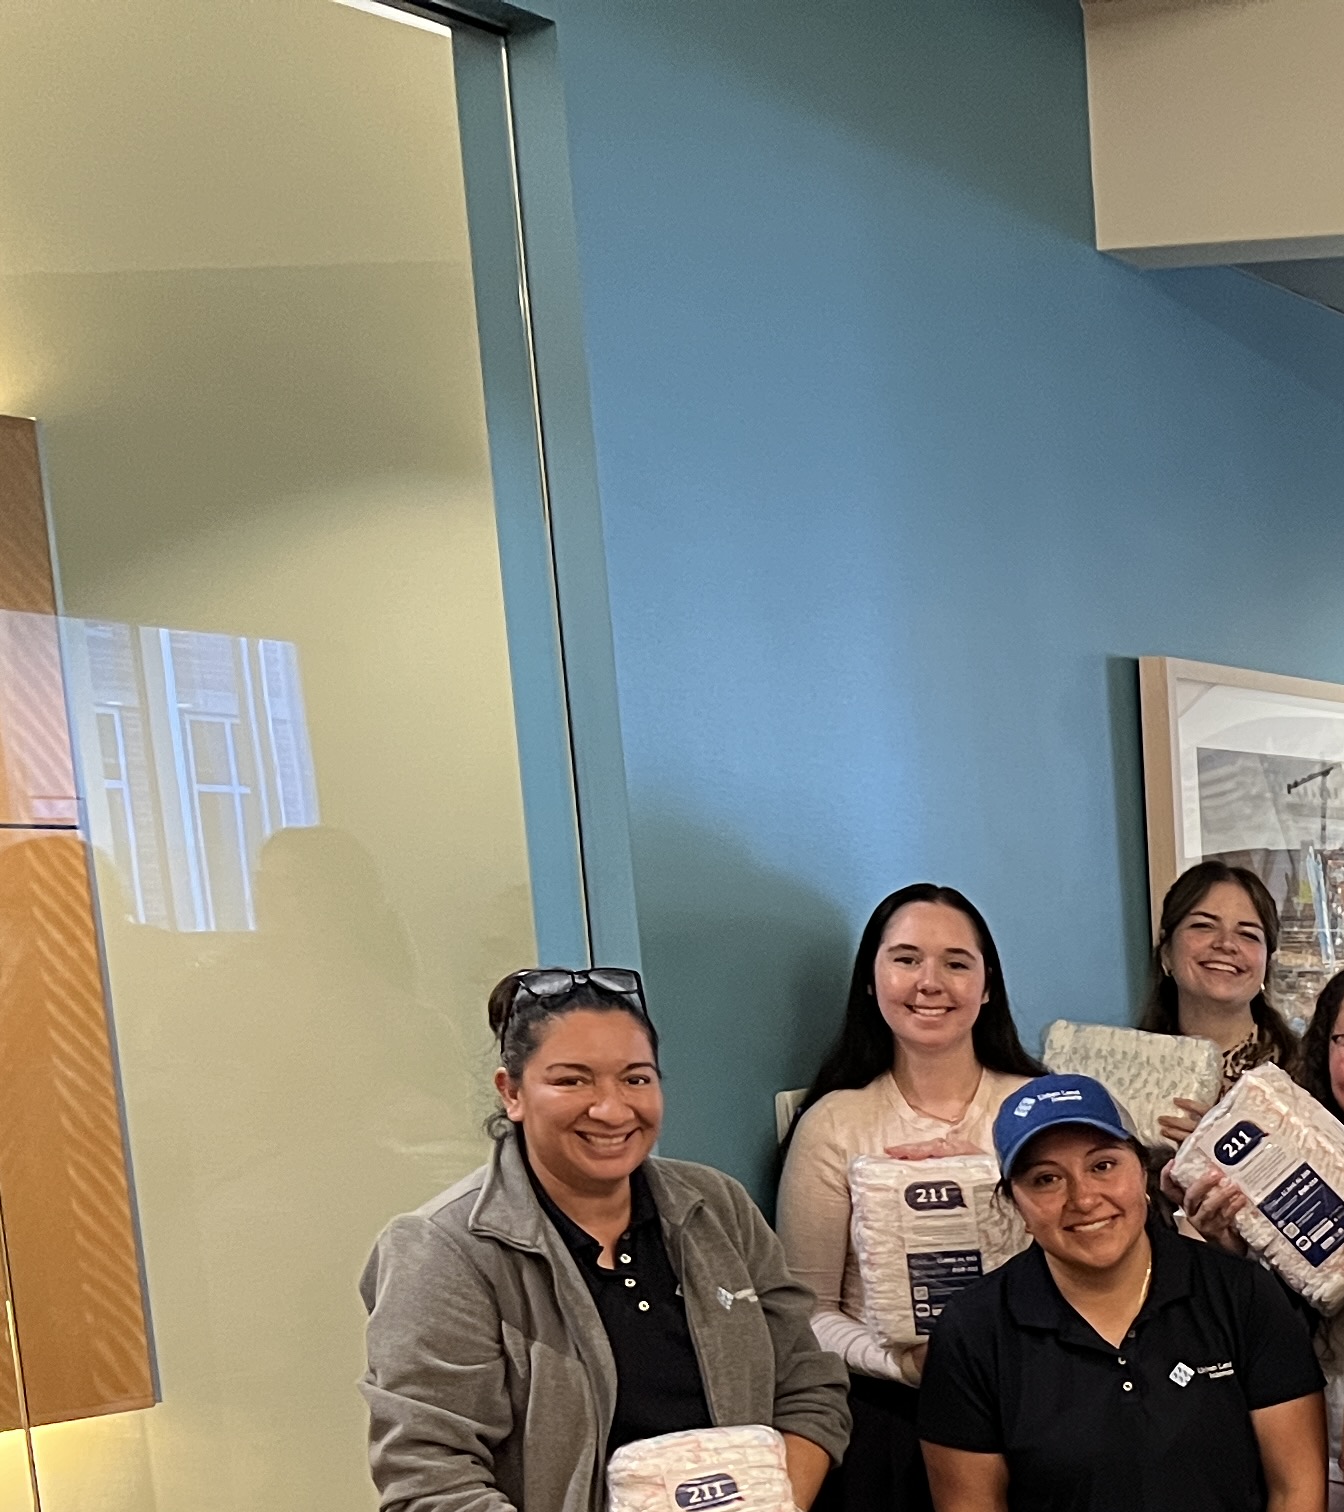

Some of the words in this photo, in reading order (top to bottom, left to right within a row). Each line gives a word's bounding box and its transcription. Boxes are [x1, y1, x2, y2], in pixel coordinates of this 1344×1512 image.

[1222, 1130, 1251, 1158] 211
[915, 1187, 950, 1203] 211
[687, 1482, 726, 1504] 211
